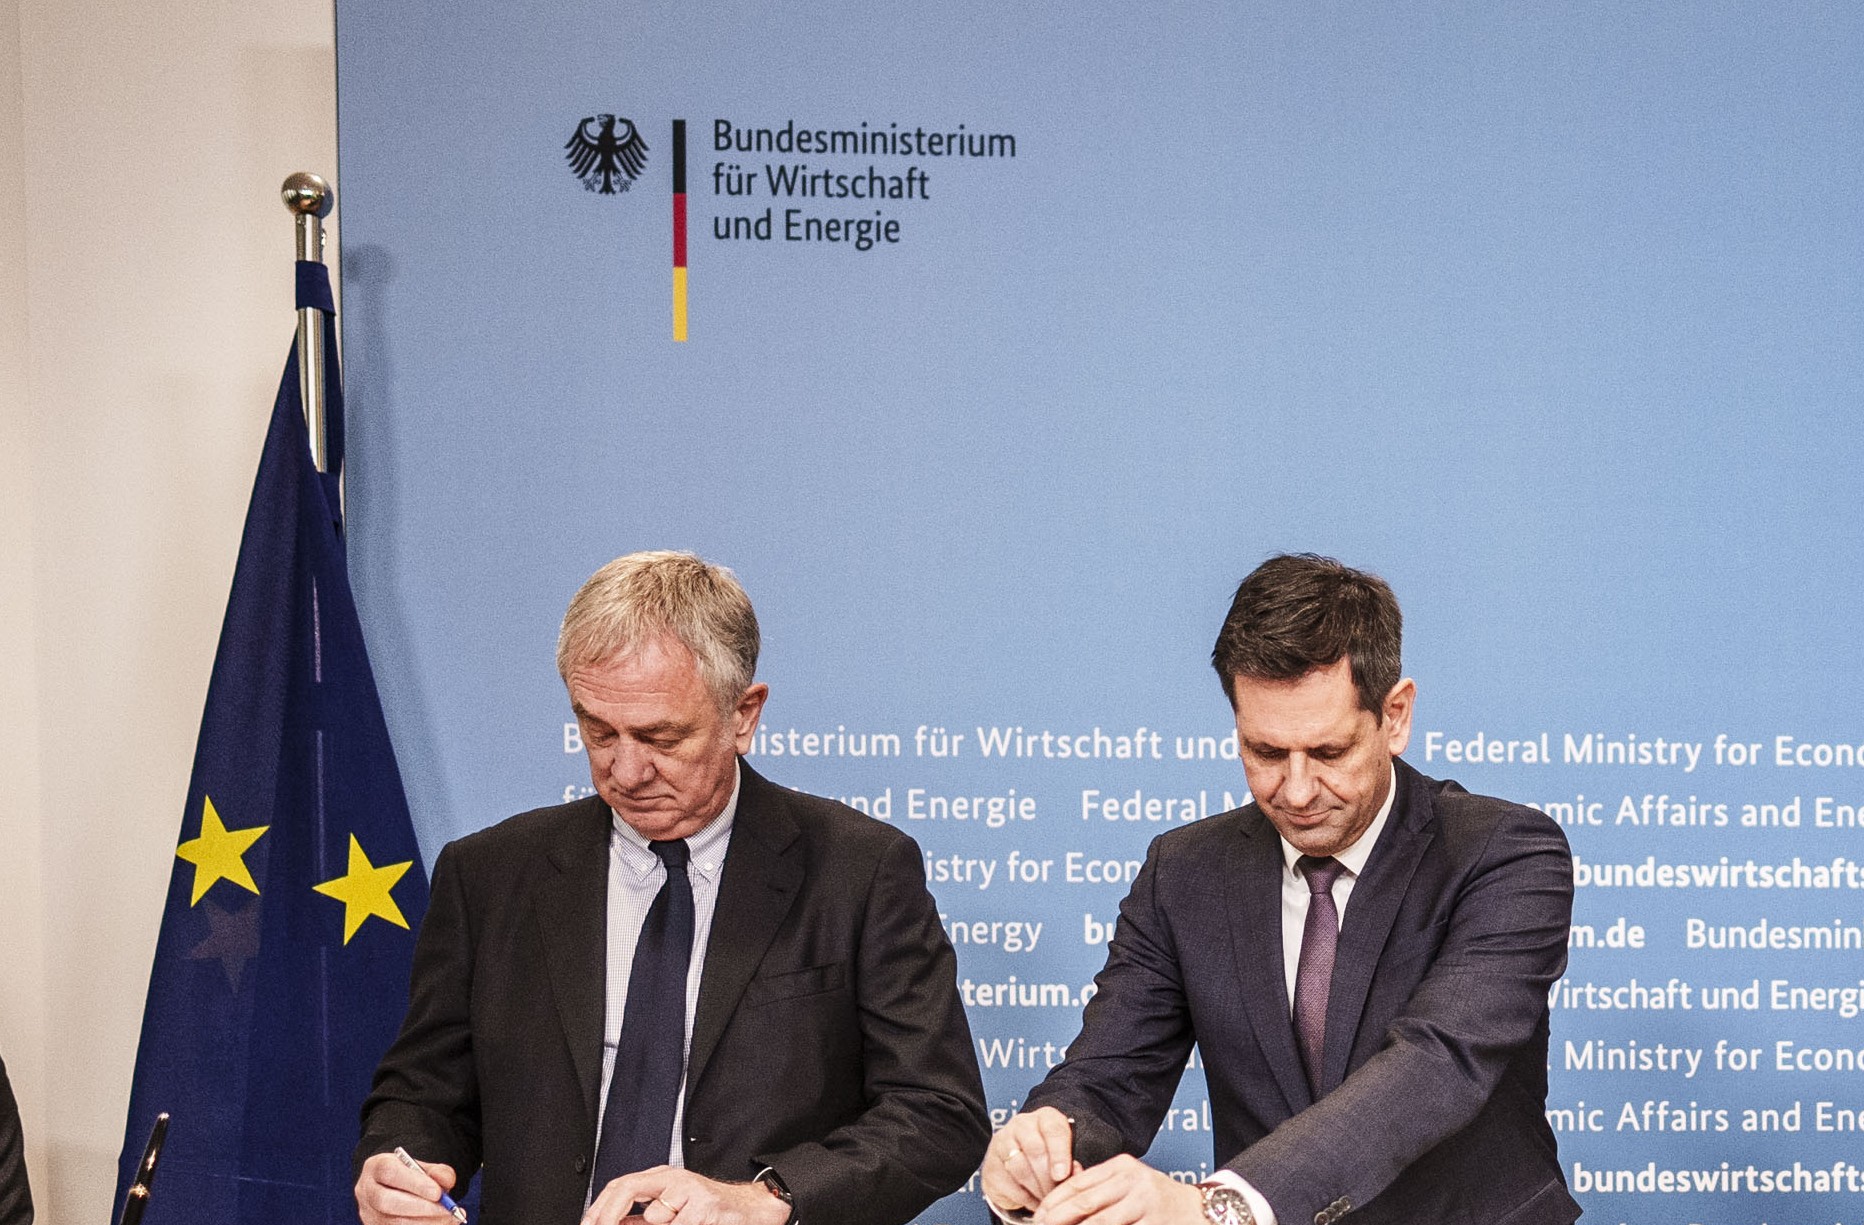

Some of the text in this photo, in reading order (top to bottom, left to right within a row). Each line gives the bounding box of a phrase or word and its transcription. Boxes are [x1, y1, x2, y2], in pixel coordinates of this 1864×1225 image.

[713, 119, 1017, 158] Bundesministerium
[713, 162, 930, 201] für Wirtschaft
[713, 208, 901, 252] und Energie
[914, 725, 965, 758] für
[976, 726, 1163, 760] Wirtschaft
[1175, 728, 1240, 760] und
[1425, 731, 1552, 765] Federal
[1563, 733, 1703, 774] Ministry
[1713, 733, 1764, 767] for
[829, 787, 892, 820] nd
[906, 788, 1037, 829] Energie
[1081, 789, 1207, 822] Federal
[1615, 794, 1730, 828] Affairs
[1739, 796, 1802, 829] and
[925, 850, 998, 891] istry
[1006, 850, 1055, 884] for
[1065, 852, 1145, 884] Econ
[1700, 979, 1761, 1011] und
[1563, 1039, 1704, 1079] Ministry
[1713, 1039, 1764, 1072] for
[1615, 1100, 1730, 1133] Affairs
[1740, 1101, 1802, 1133] and
